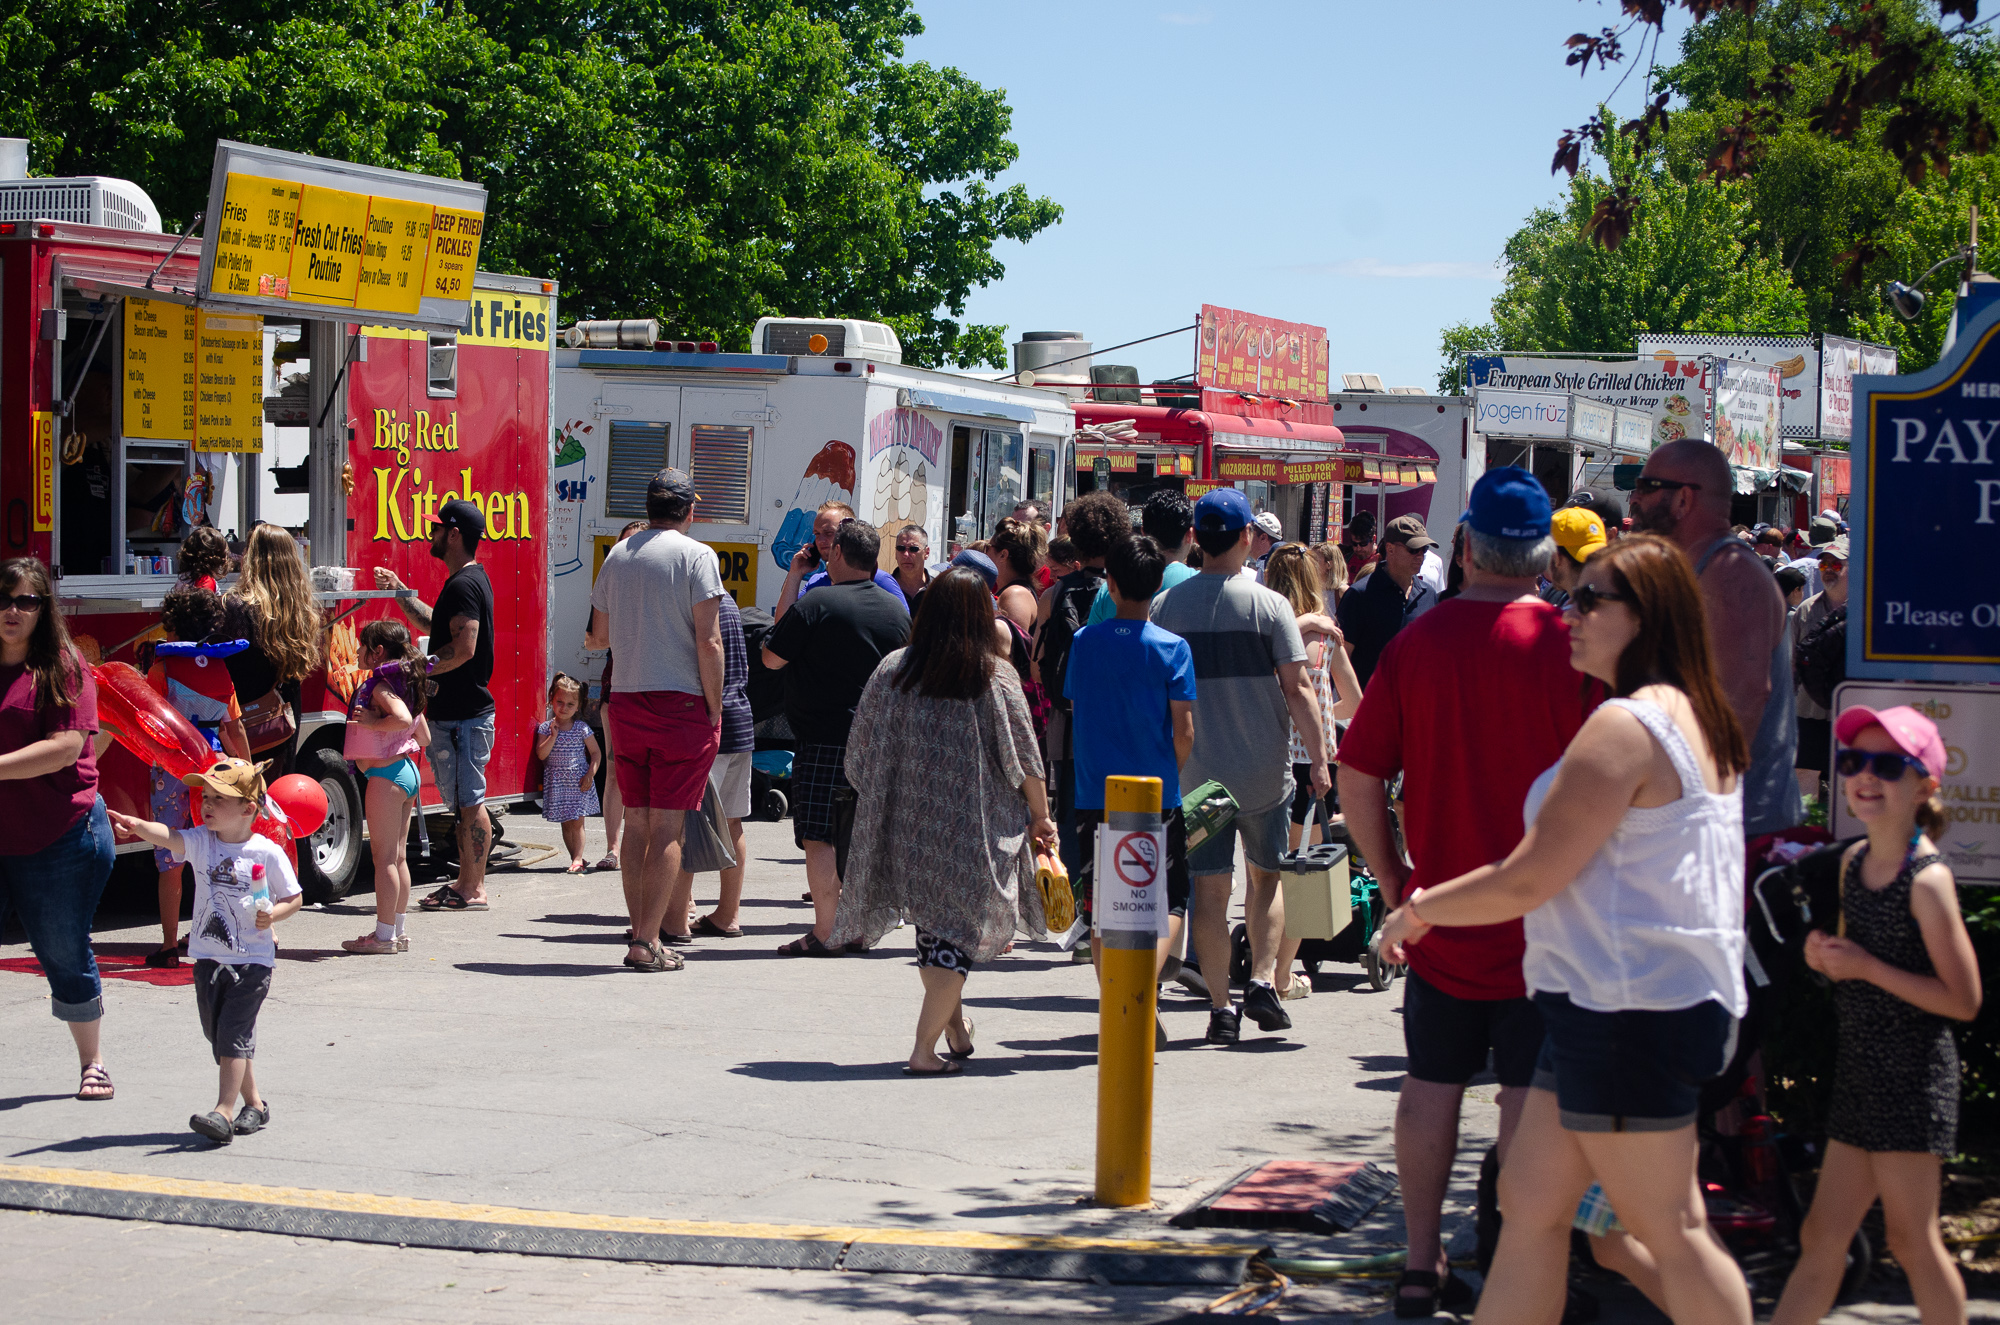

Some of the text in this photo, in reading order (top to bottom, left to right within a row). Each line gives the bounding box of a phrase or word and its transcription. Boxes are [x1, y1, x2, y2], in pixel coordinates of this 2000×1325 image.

[224, 202, 247, 222] Fries
[368, 214, 393, 234] Poutine
[433, 213, 482, 236] DEEP FRIED
[247, 231, 262, 249] cheese
[294, 219, 363, 255] Fresh Cut Fries
[436, 236, 473, 257] PICKLES
[228, 252, 243, 271] Pulled
[308, 252, 342, 283] Poutine
[439, 260, 463, 271] 3 spears
[234, 273, 250, 292] Cheese
[377, 268, 391, 286] Cheese
[436, 277, 460, 294] $4.50
[144, 310, 157, 322] Cheese
[491, 300, 546, 342] Fries
[129, 348, 138, 360] Corn
[136, 370, 144, 384] Dog
[200, 373, 213, 384] Chicken
[1489, 369, 1685, 392] European Style Grilled Chicken
[142, 388, 155, 400] Cheese
[1630, 396, 1659, 408] Wrap
[1478, 402, 1566, 424] yogen früz
[200, 436, 208, 450] Deep
[373, 408, 459, 467] Big Red
[909, 410, 942, 469] DAIRY
[1891, 418, 2000, 464] PAY
[43, 420, 51, 506] ORDER
[1076, 453, 1135, 468] HICKE OUVLAKI
[1220, 463, 1277, 476] MOZARRELLA STIC
[1283, 463, 1337, 474] PULLED PORK
[1288, 472, 1331, 482] SANDWICH
[1502, 527, 1538, 537] BLUE JAYS
[719, 551, 749, 582] OR
[1885, 601, 1963, 626] Please
[1130, 889, 1146, 899] NO
[1112, 902, 1158, 912] SMOKING
